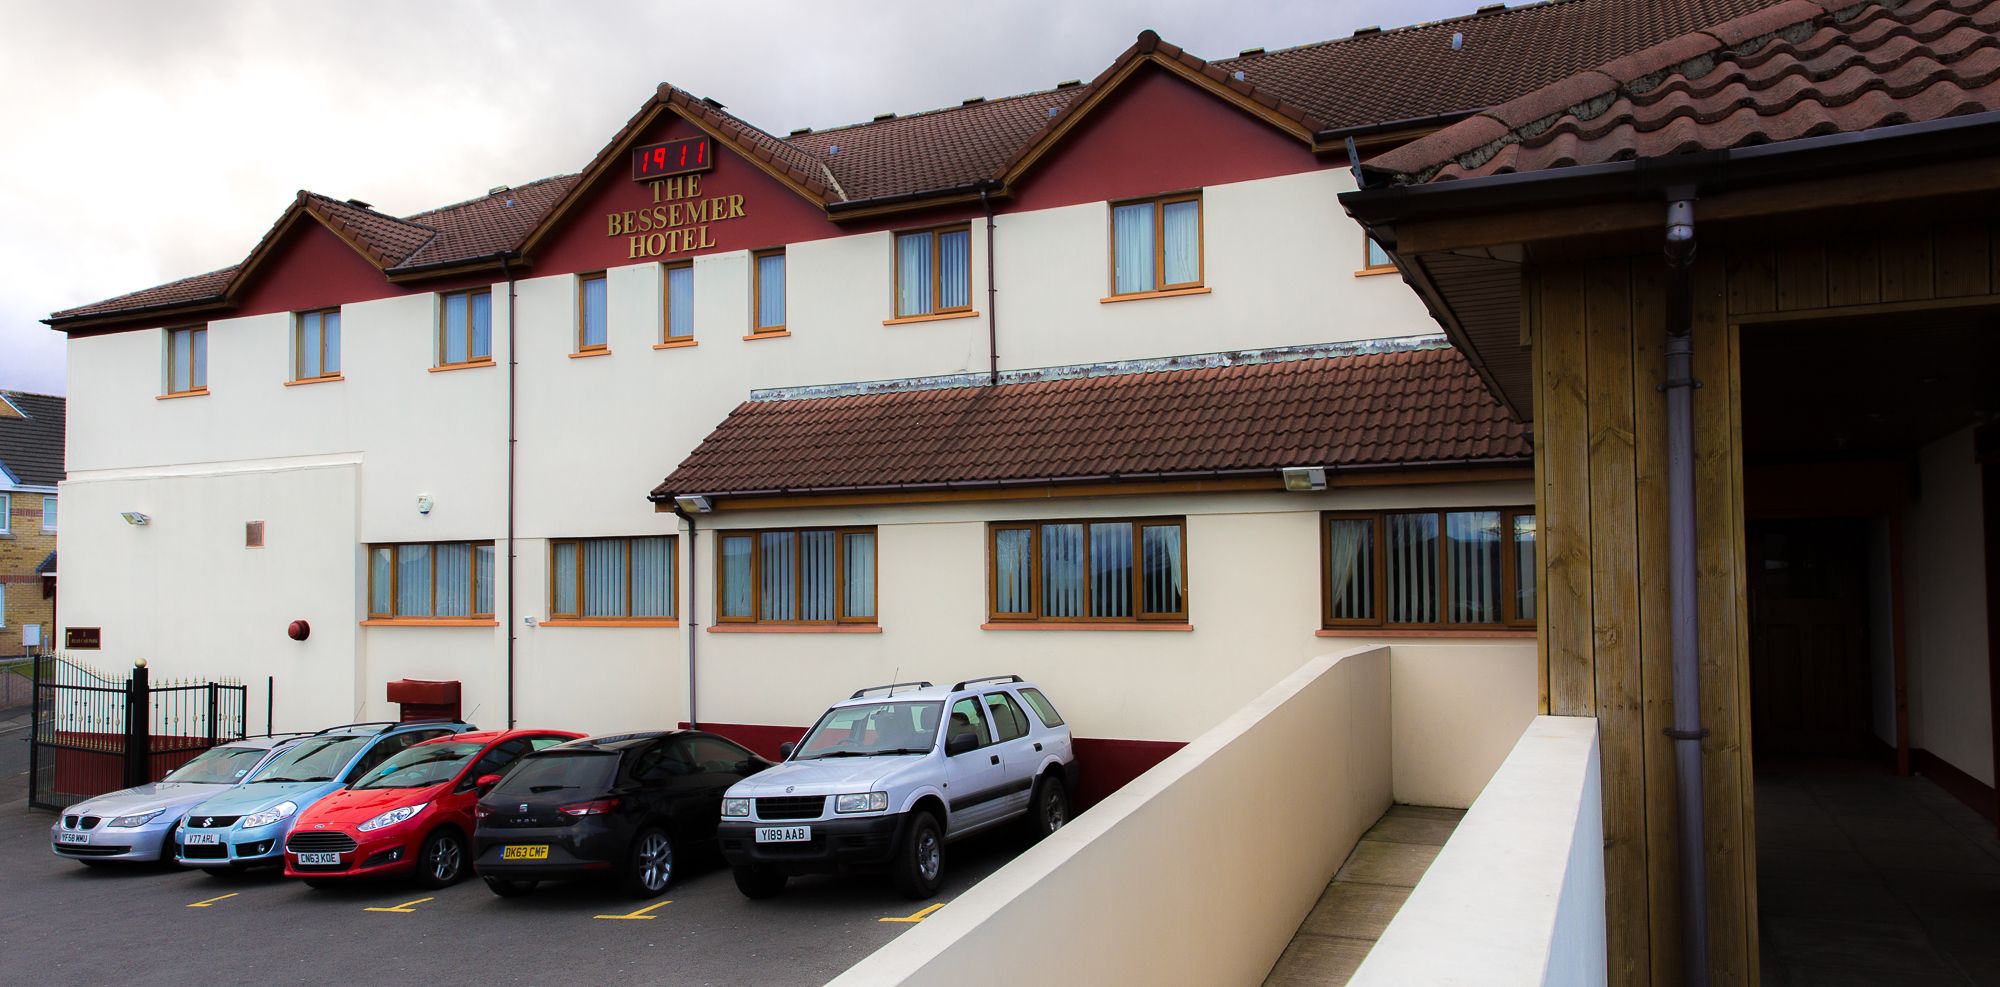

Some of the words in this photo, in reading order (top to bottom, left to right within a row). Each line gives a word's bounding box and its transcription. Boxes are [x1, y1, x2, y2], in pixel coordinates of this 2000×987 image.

[649, 174, 702, 203] THE
[607, 193, 746, 237] BESSEMER
[628, 225, 716, 259] HOTEL
[785, 827, 805, 840] AAB
[300, 853, 320, 863] CN63
[505, 847, 528, 858] DK63
[529, 846, 547, 857] CMF
